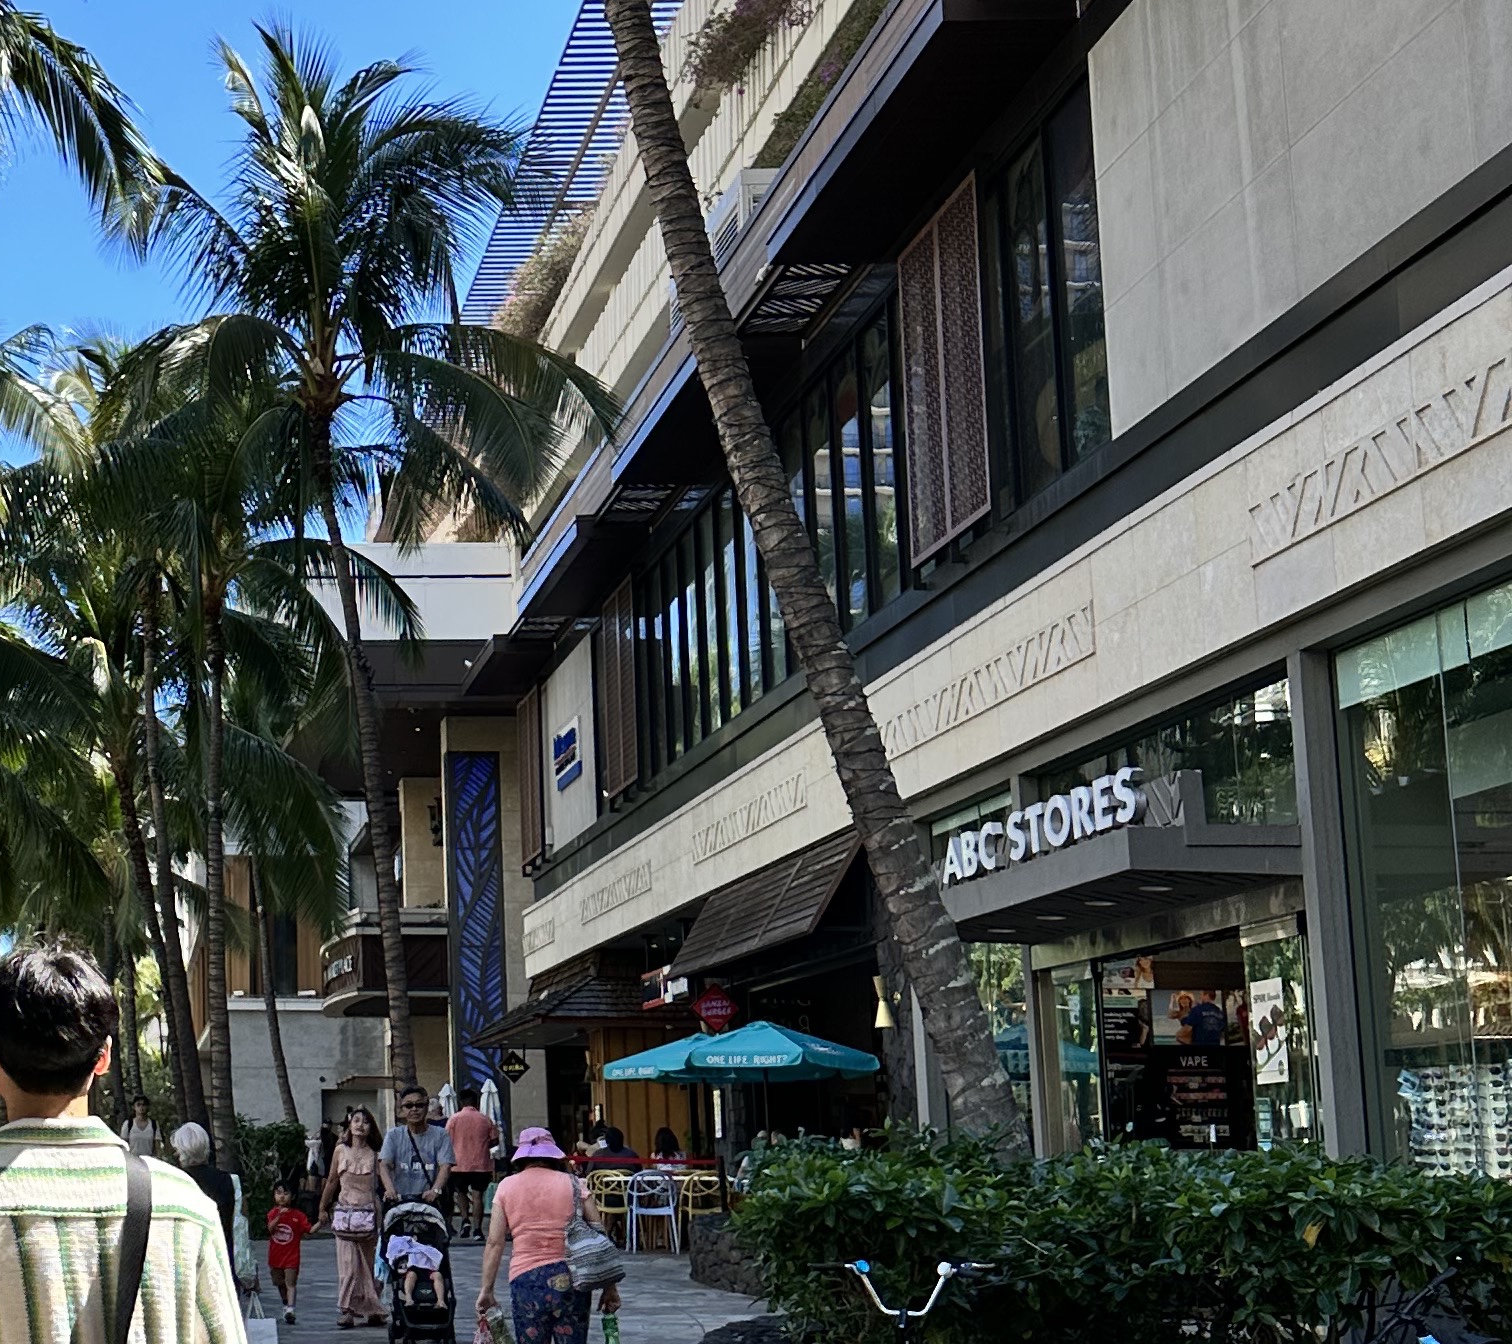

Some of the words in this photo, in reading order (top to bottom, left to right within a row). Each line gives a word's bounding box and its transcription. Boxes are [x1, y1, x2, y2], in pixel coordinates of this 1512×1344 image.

[943, 821, 1003, 884] ABC
[1006, 766, 1144, 861] STORES
[706, 1055, 726, 1065] ONE
[729, 1055, 749, 1065] LIFE
[753, 1054, 789, 1065] RIGHT?
[1180, 1056, 1208, 1067] VAPE
